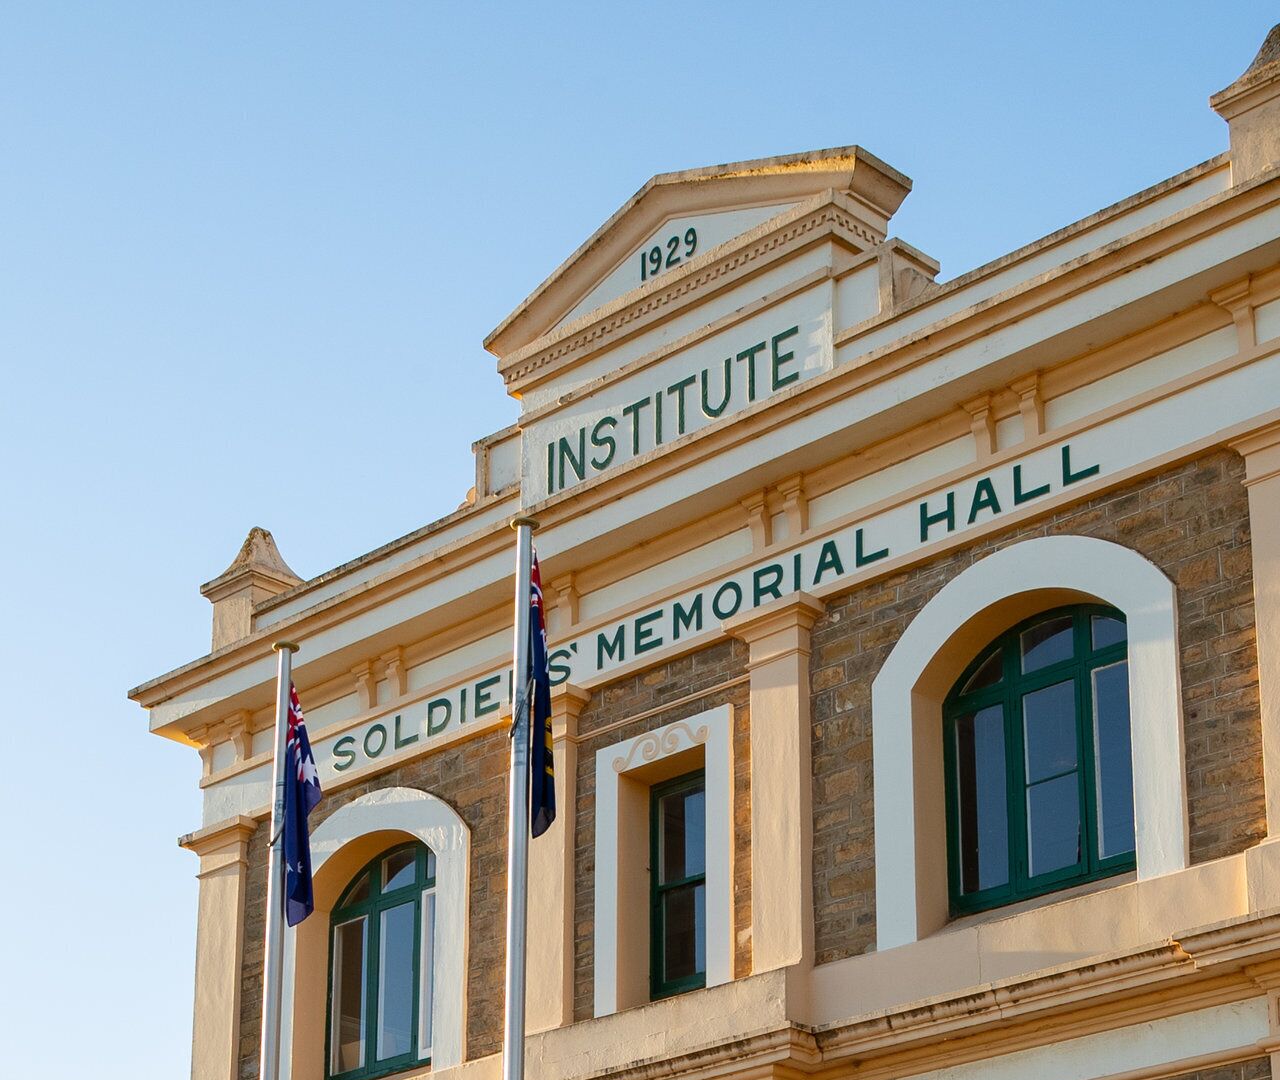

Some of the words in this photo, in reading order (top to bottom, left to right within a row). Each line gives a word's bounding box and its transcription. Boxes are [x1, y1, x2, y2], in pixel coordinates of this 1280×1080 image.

[640, 226, 698, 281] 1929
[547, 324, 799, 495] INSTITUTE
[332, 642, 578, 772] SOLDIES'
[597, 528, 889, 670] MEMORIAL
[919, 444, 1100, 543] HALL
